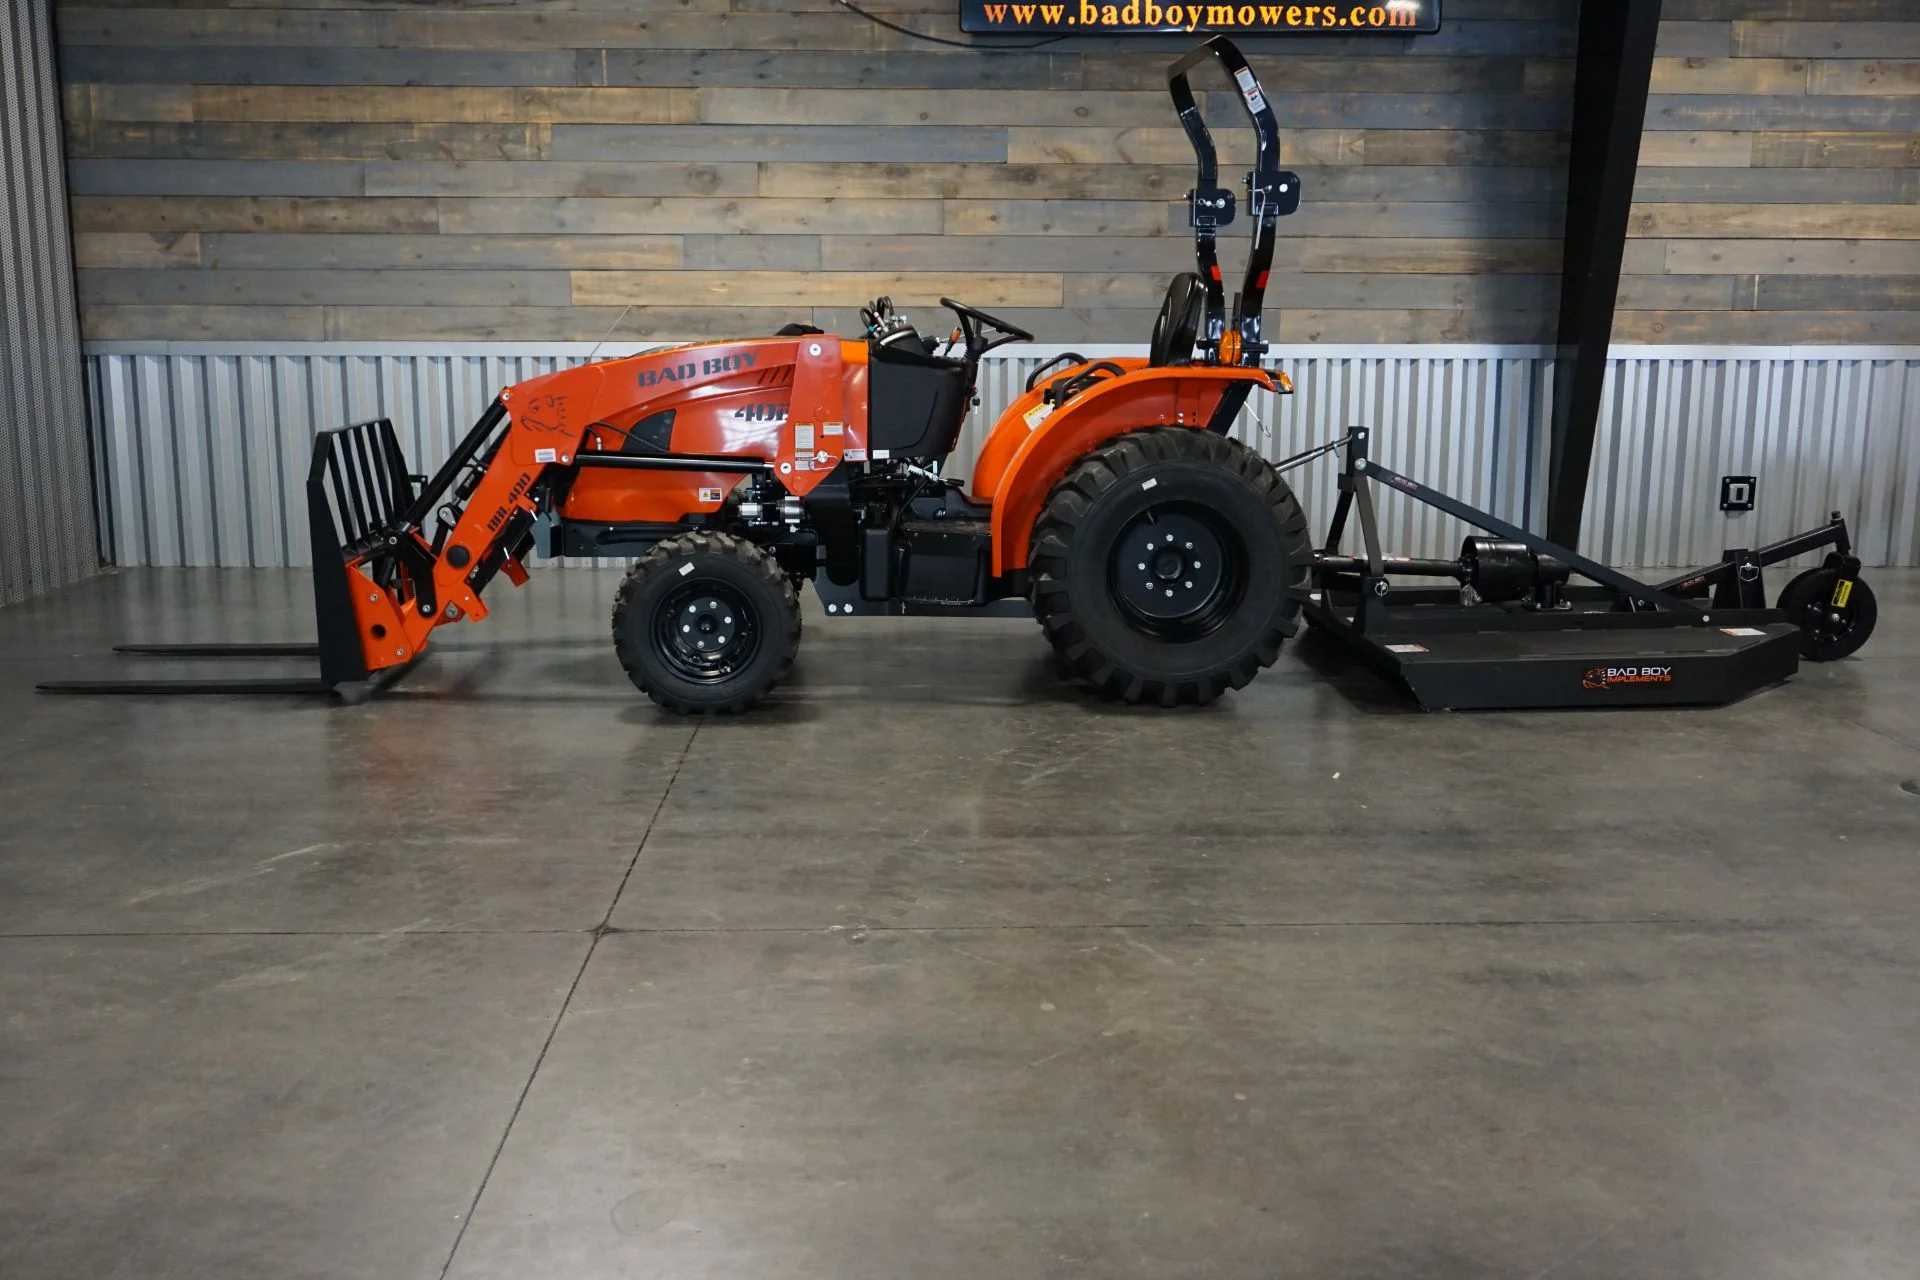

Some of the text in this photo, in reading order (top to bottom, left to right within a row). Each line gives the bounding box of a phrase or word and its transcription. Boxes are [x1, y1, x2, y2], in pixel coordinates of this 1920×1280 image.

[638, 352, 759, 387] BAD BOY
[1607, 666, 1672, 676] BAD BOY
[1607, 675, 1672, 683] IMPLEMENTS
